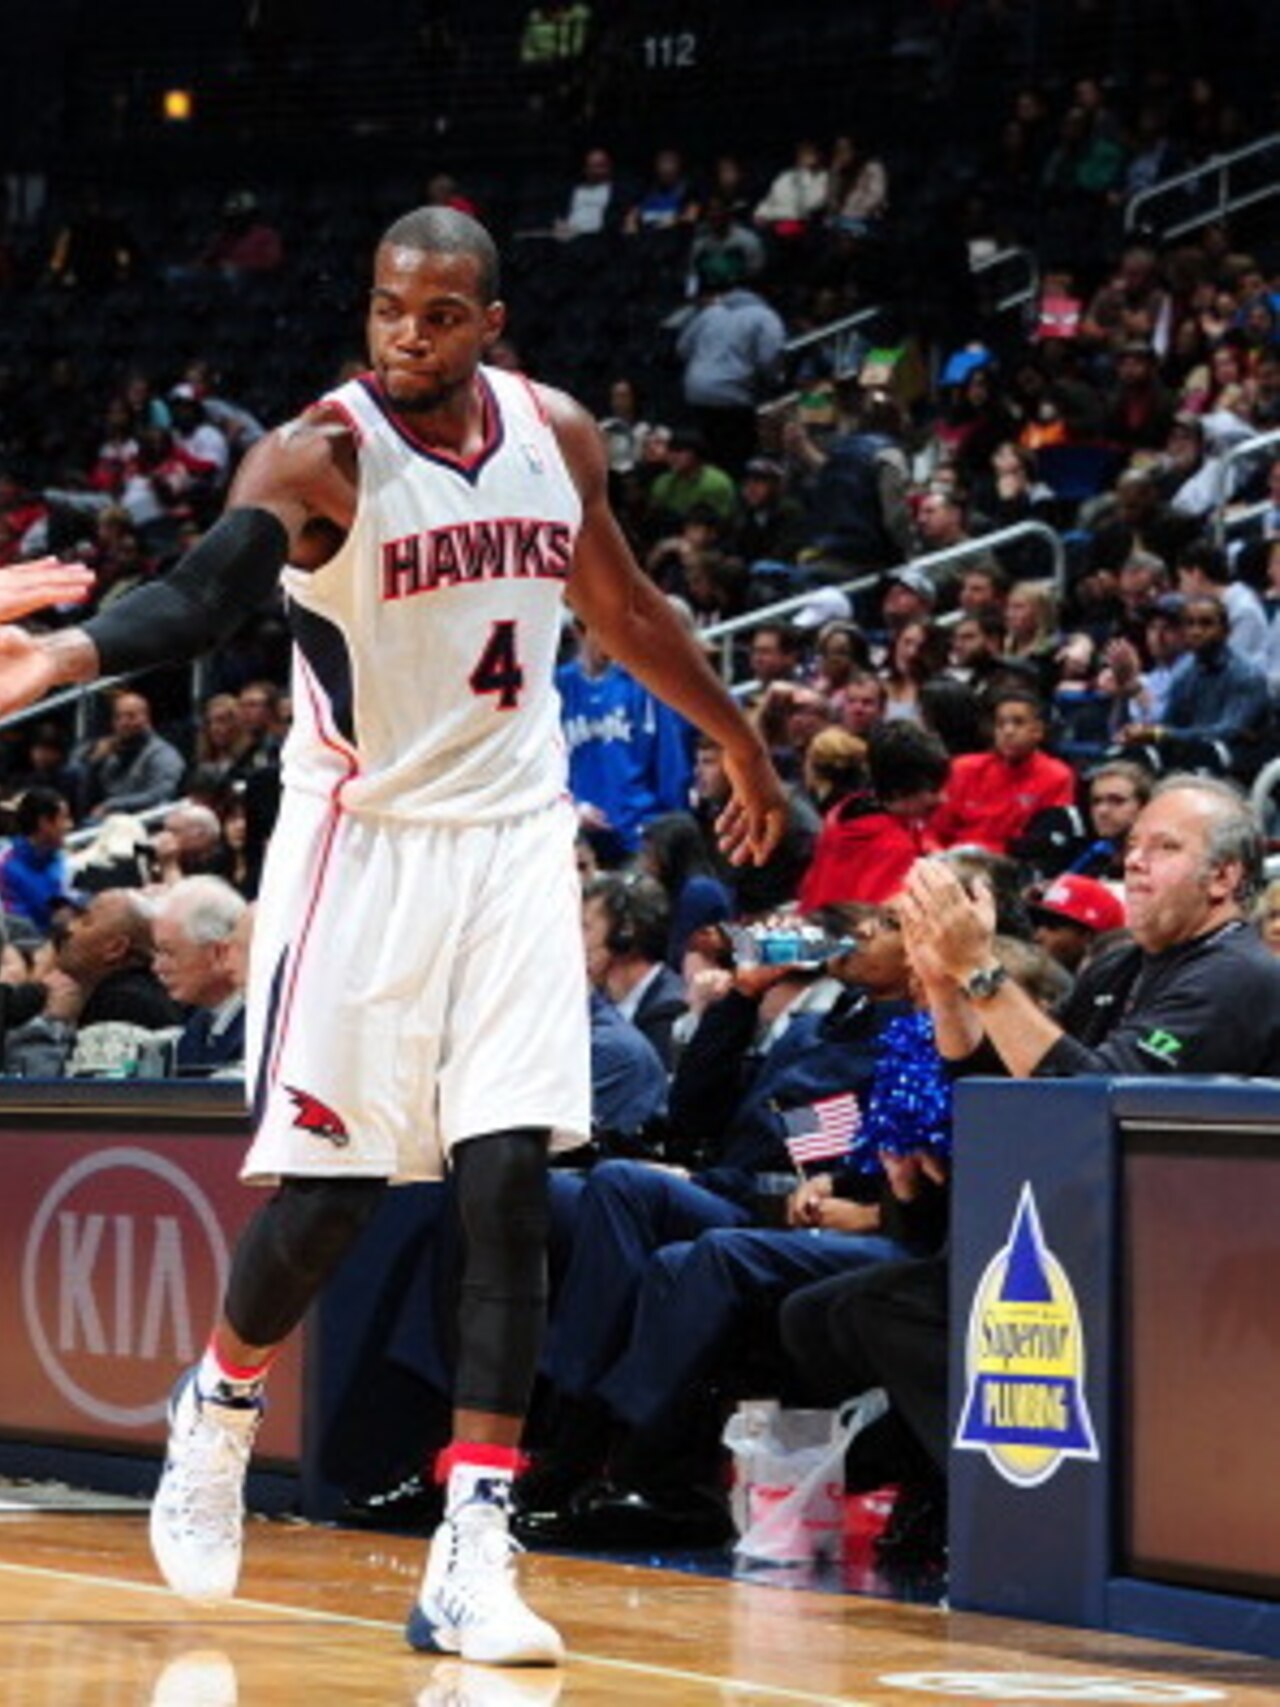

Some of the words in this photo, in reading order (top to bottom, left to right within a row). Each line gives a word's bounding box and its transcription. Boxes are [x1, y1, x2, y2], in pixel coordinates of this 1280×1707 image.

[644, 33, 697, 68] 112
[382, 516, 572, 600] HAWKS
[468, 618, 524, 711] 4
[58, 1211, 195, 1361] KIA
[982, 1310, 1069, 1370] Superior
[982, 1379, 1068, 1432] PLUMBING
